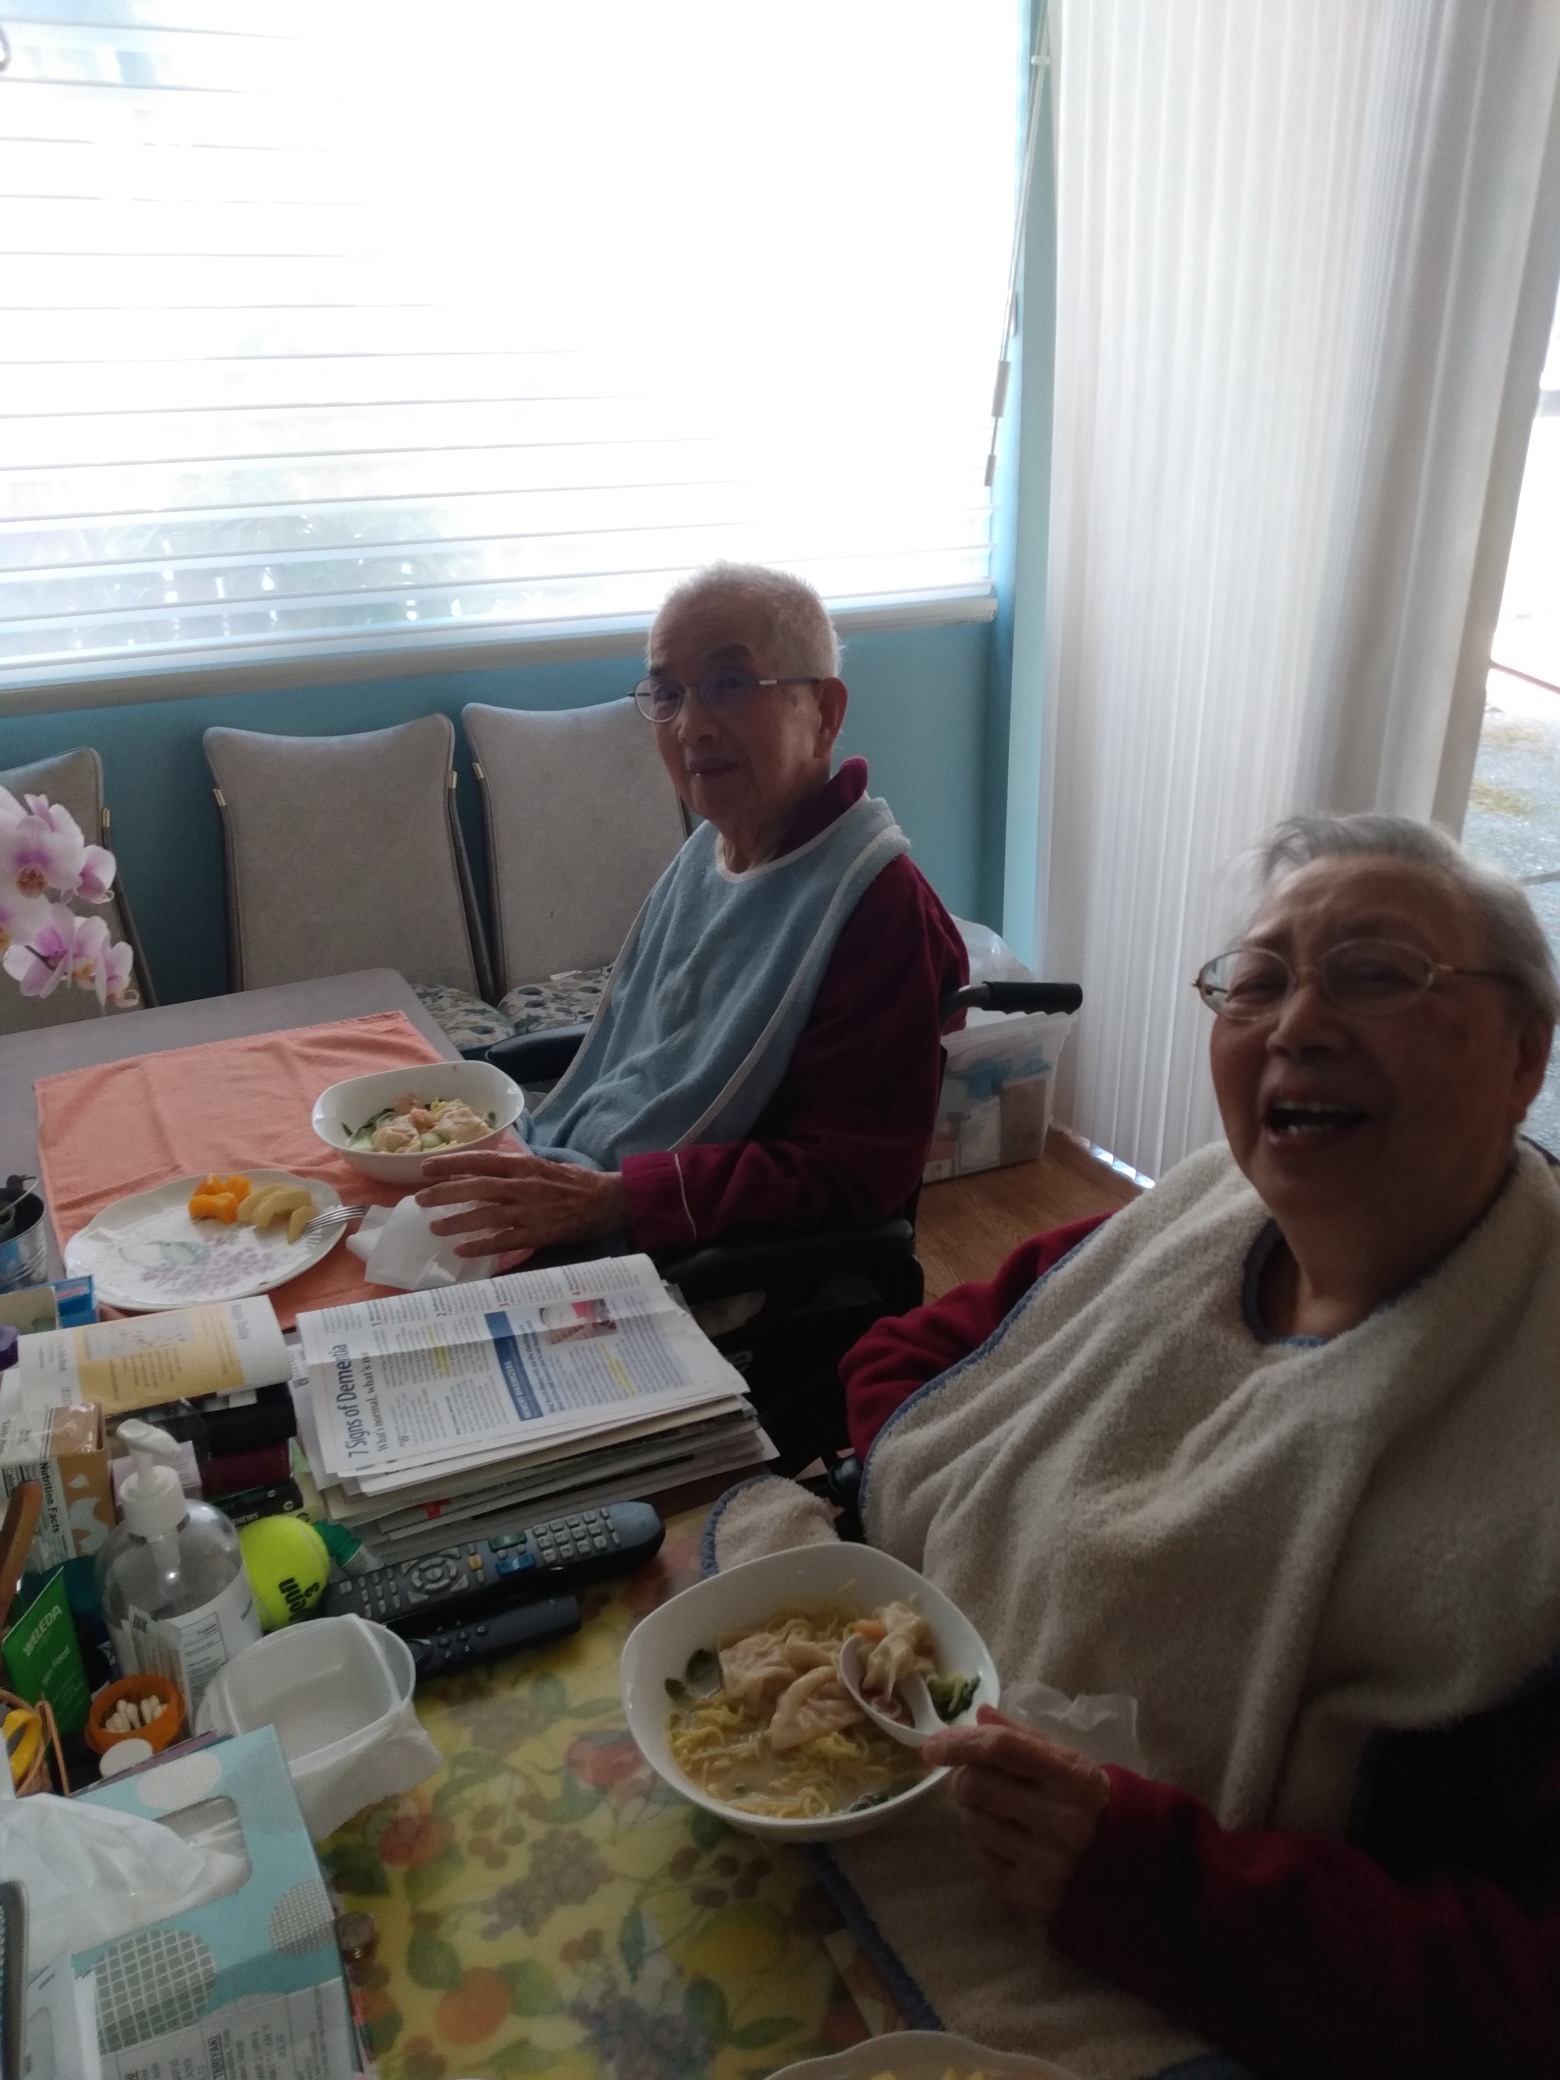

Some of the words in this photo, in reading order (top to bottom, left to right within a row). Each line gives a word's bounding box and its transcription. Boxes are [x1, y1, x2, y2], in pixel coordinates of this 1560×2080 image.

[328, 1343, 356, 1402] Dementia
[360, 1364, 375, 1395] what's
[337, 1403, 360, 1417] of
[366, 1394, 383, 1426] normal,
[345, 1418, 370, 1449] Signs
[373, 1427, 389, 1452] What's
[348, 1449, 369, 1458] 7
[40, 1461, 55, 1505] Nutrition
[47, 1507, 62, 1534] Facts
[23, 1605, 62, 1657] WELEDA
